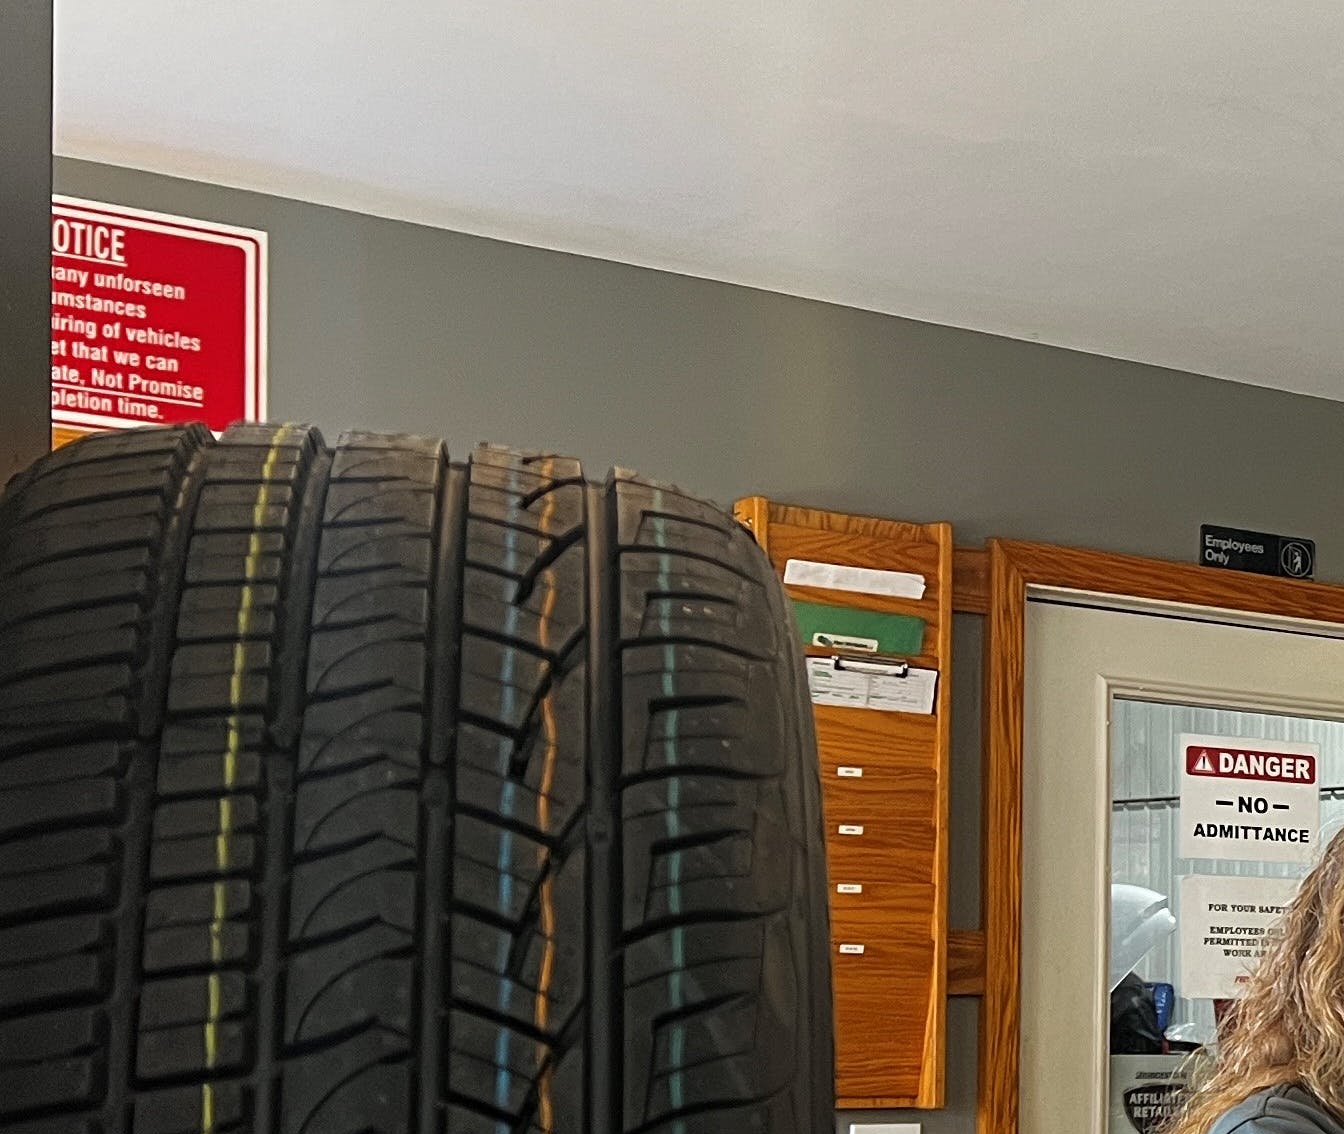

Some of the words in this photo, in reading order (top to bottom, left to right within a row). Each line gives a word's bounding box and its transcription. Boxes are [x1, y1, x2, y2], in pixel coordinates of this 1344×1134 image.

[52, 219, 126, 262] OTICE
[93, 273, 186, 300] unforseen
[51, 313, 97, 339] iring
[102, 322, 121, 339] of
[125, 327, 201, 352] vehicles
[71, 341, 109, 363] that
[113, 351, 141, 367] we
[145, 356, 179, 373] can
[91, 368, 123, 390] Not
[128, 373, 204, 401] Promise
[117, 397, 165, 420] time.
[1204, 534, 1264, 554] Employees
[1204, 548, 1230, 565] Only
[1218, 752, 1311, 780] DANGER
[1238, 796, 1269, 814] NO
[1193, 823, 1310, 844] ADMITTANCE
[1208, 903, 1228, 912] FOR
[1230, 904, 1256, 913] YOUR
[1258, 905, 1289, 914] SAFET
[1209, 926, 1265, 936] EMPLOYEES
[1203, 938, 1258, 947] PERMITTED
[1223, 949, 1252, 957] WORK
